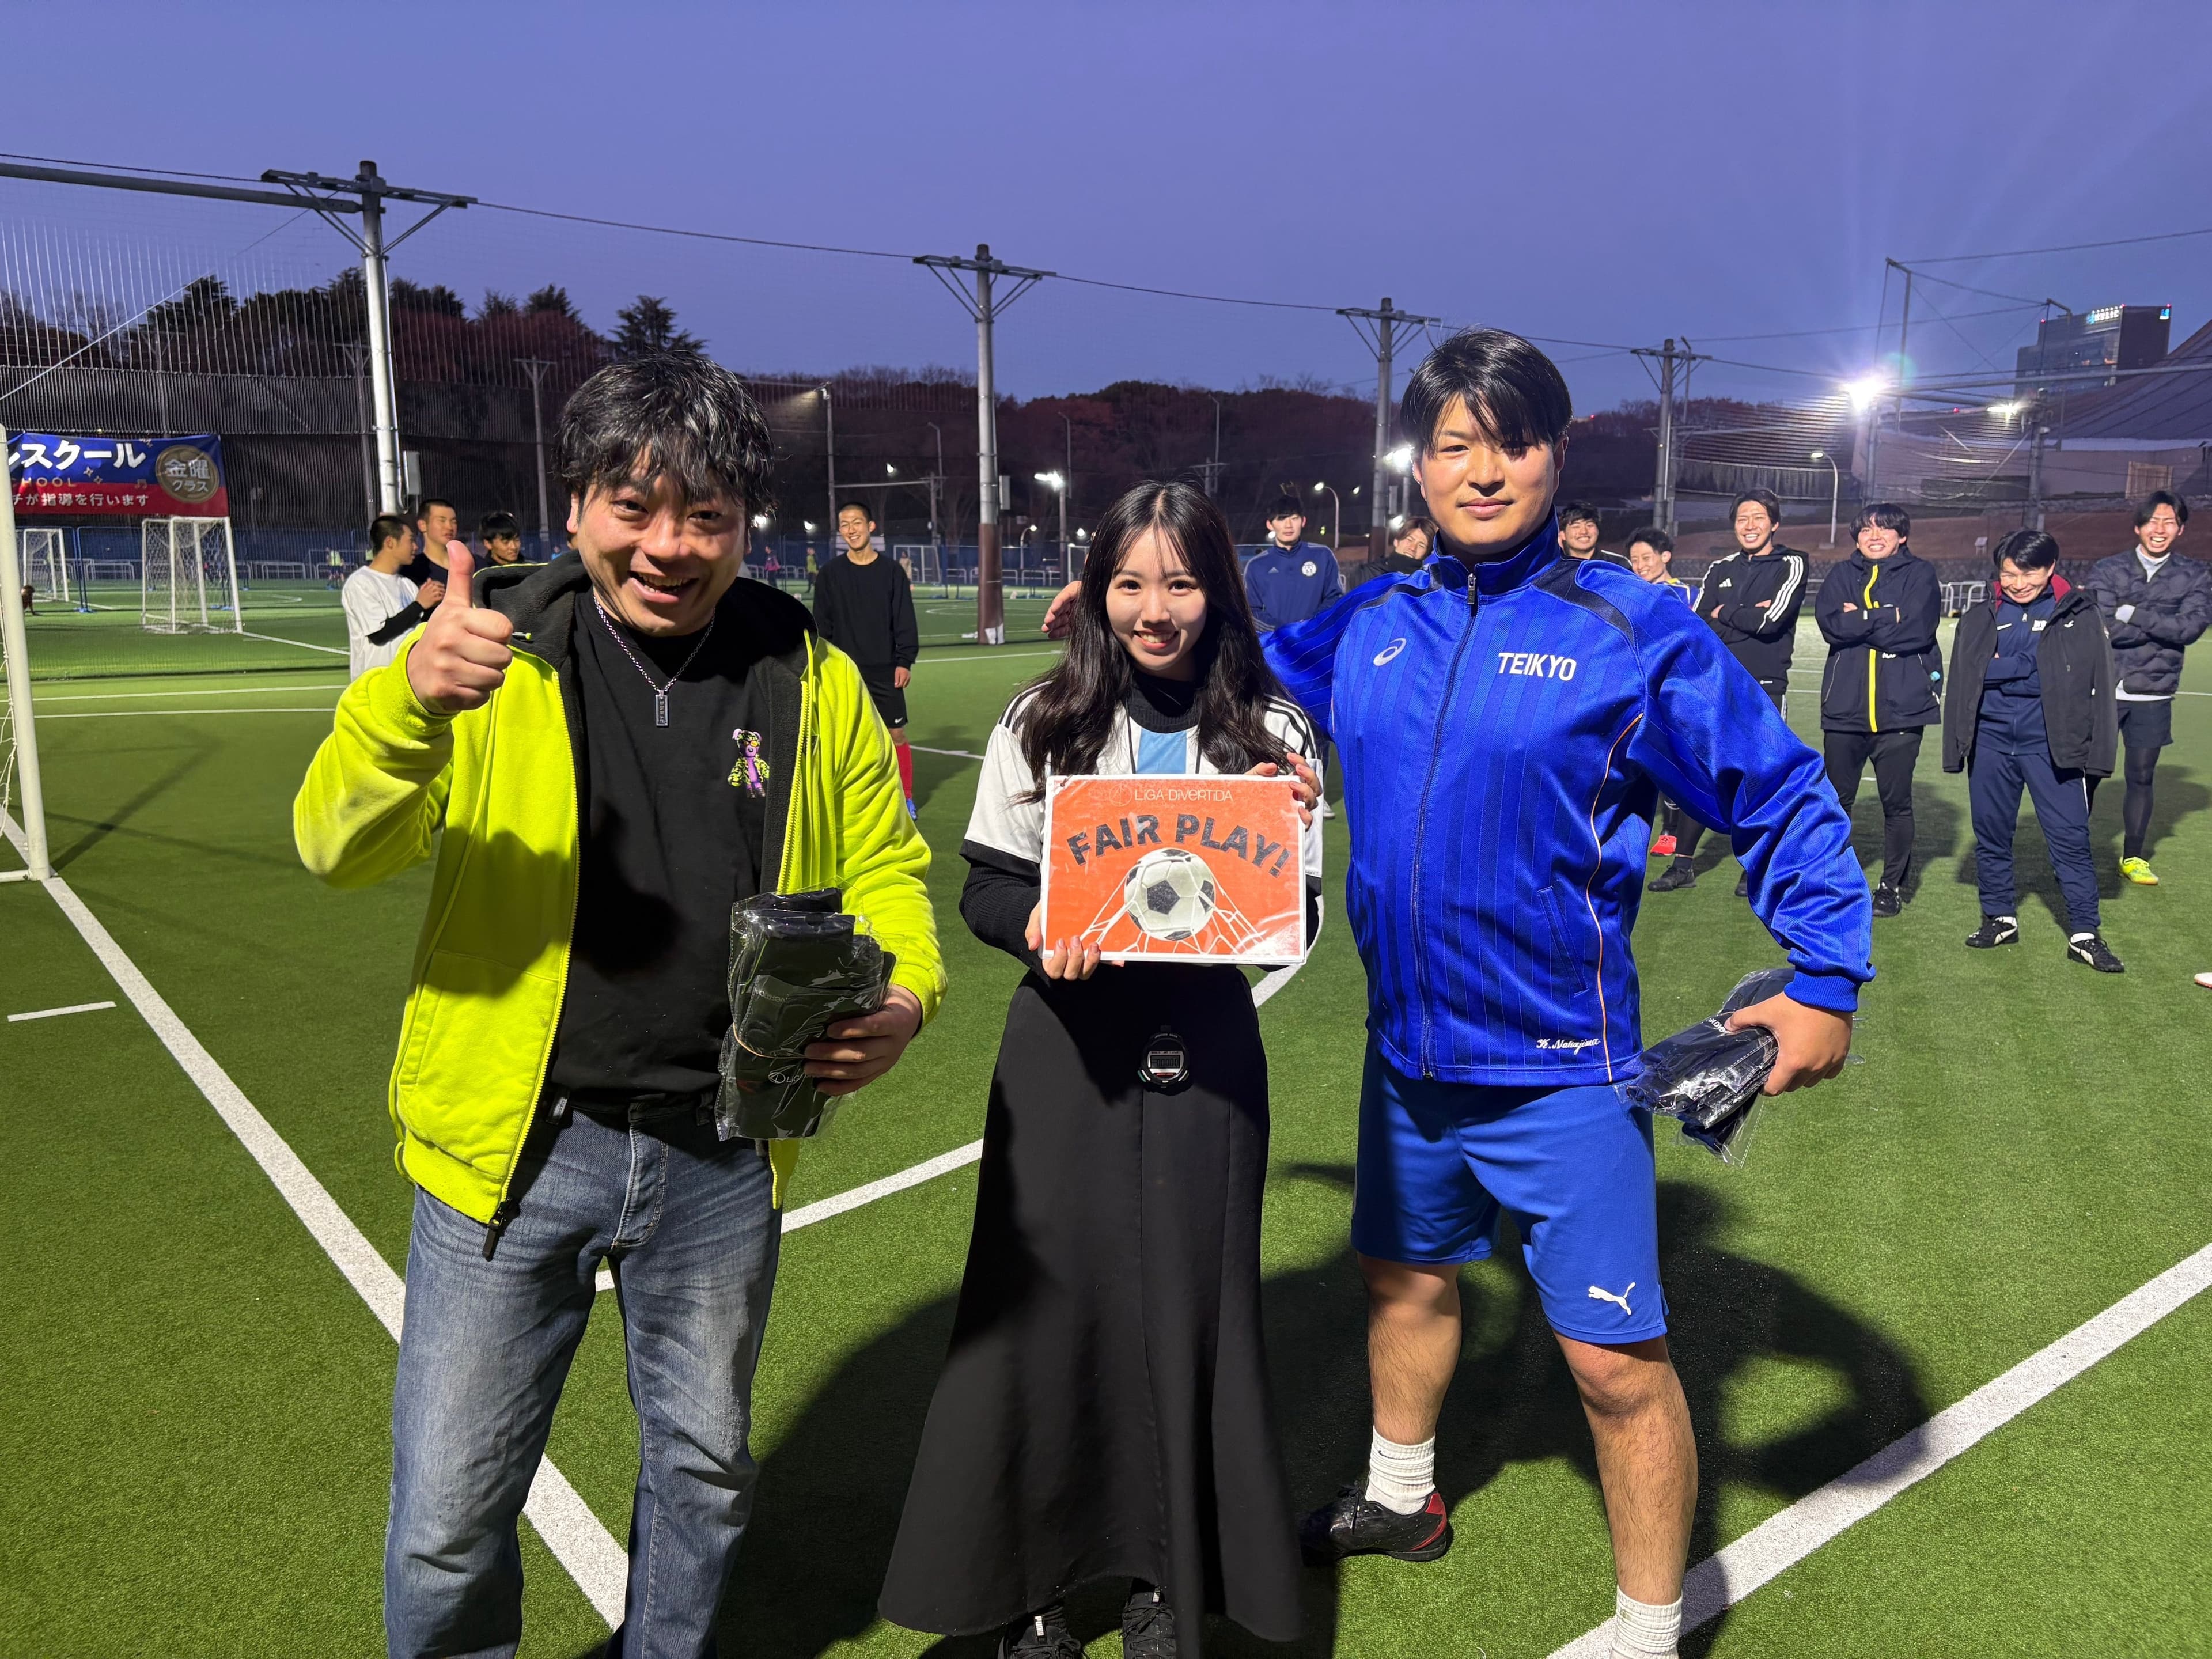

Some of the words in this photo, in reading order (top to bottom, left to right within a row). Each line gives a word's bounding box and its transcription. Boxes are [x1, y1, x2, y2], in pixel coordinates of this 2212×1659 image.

[165, 460, 211, 480] 金曜
[172, 480, 209, 493] クラス
[1498, 652, 1577, 681] TEIKYO
[1066, 813, 1162, 866] FAIR
[1175, 813, 1293, 878] PLAY!
